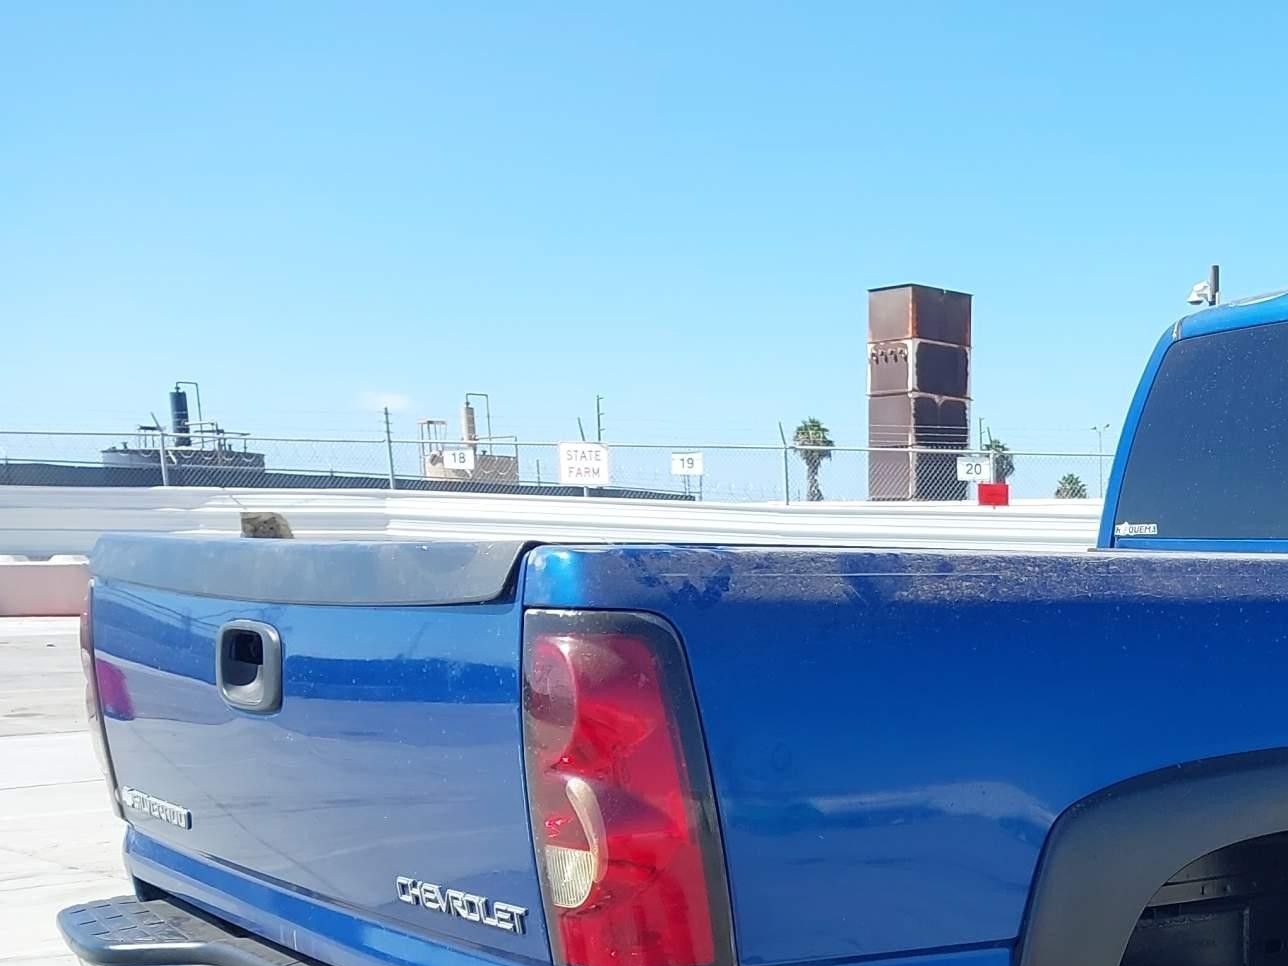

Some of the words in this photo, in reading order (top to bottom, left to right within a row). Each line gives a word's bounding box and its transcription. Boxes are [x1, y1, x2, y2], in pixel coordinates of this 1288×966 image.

[451, 452, 466, 464] 18
[566, 450, 601, 461] STATE
[680, 457, 695, 469] 19
[966, 463, 982, 475] 20
[568, 467, 600, 478] FARM
[396, 875, 528, 935] CHEVROLET
